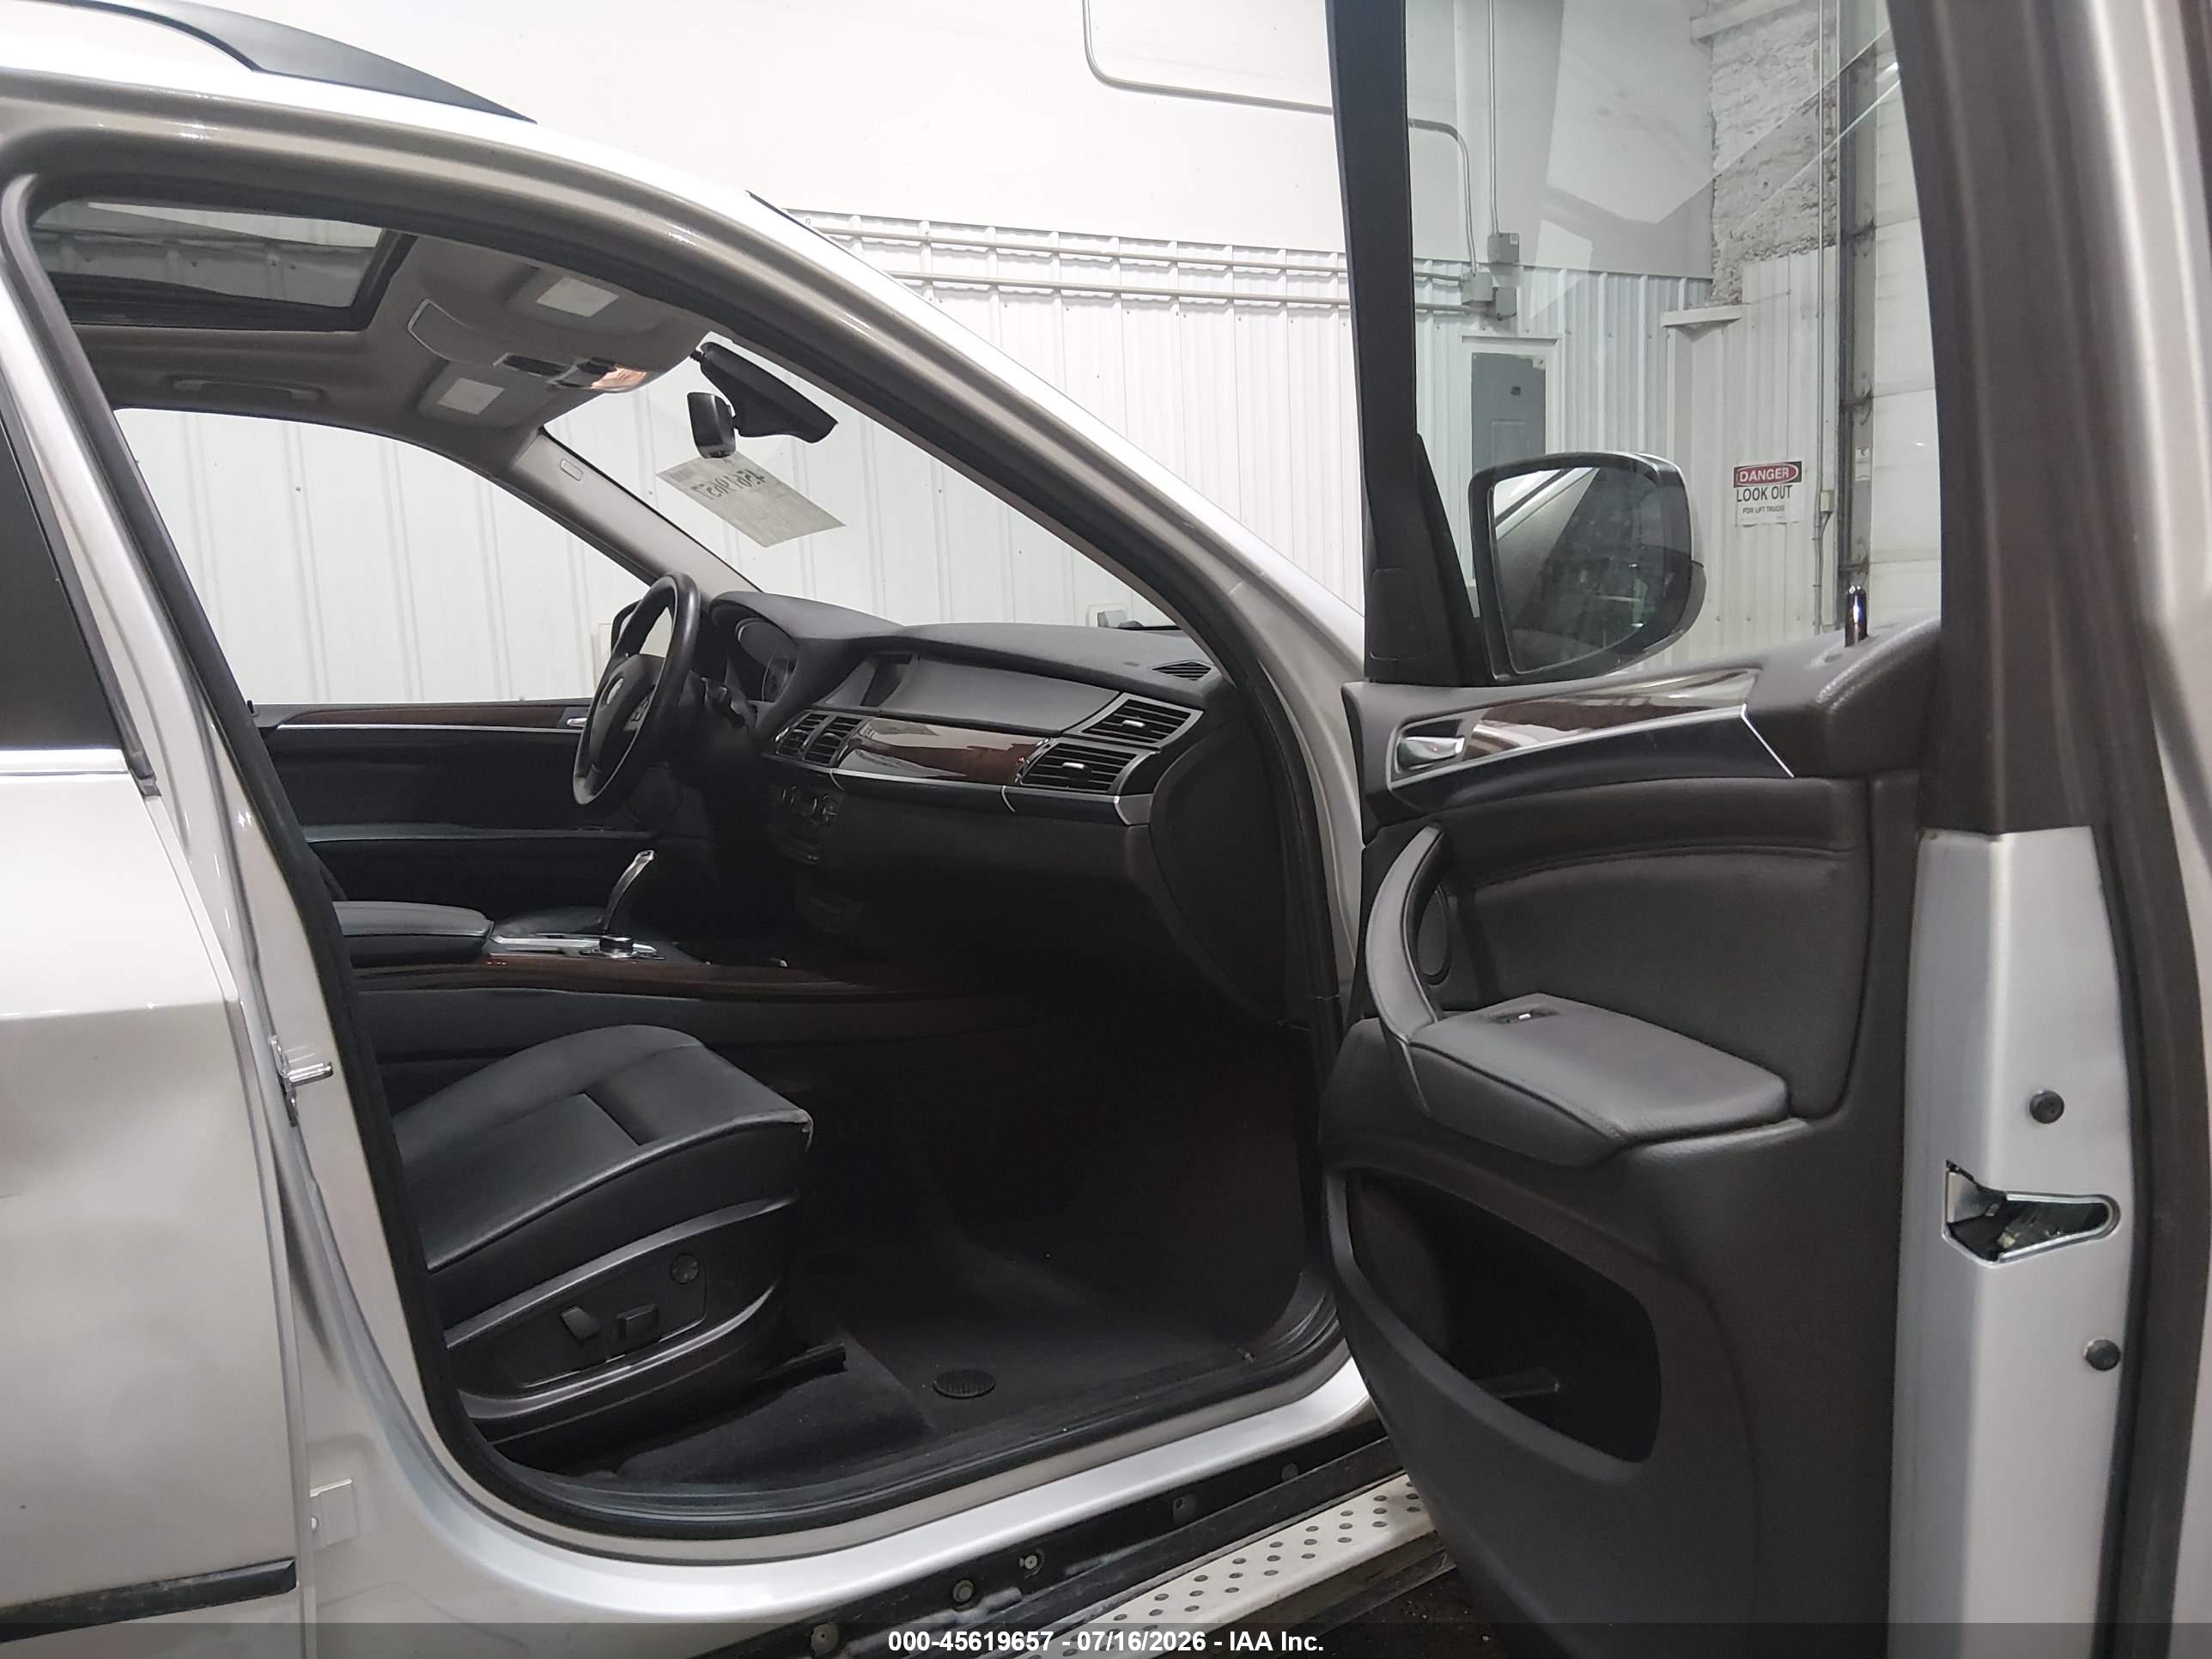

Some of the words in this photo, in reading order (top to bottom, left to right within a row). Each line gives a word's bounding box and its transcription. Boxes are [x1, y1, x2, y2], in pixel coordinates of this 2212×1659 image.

[1739, 467, 1790, 483] DANGER
[1736, 486, 1769, 502] LOOK
[1771, 485, 1793, 500] OUT
